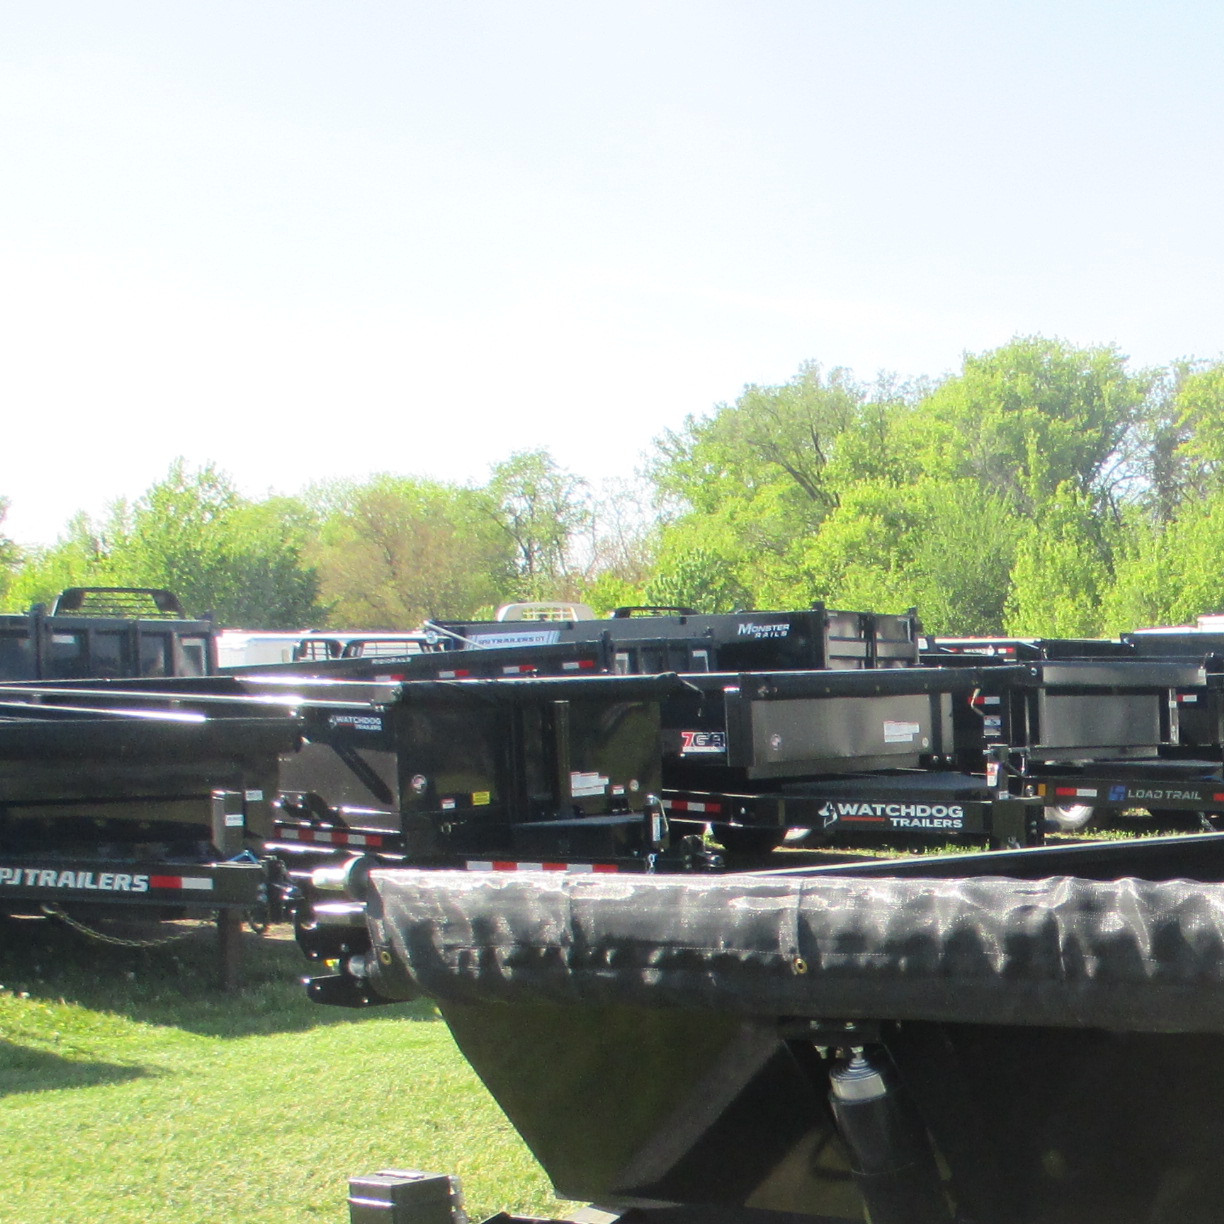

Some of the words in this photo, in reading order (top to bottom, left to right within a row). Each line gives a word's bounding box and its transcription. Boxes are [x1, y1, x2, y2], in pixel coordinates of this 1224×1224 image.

[737, 623, 790, 636] MONSTER
[337, 716, 382, 725] WATCHDOG
[1128, 789, 1163, 799] LOAD
[1165, 791, 1202, 800] TRAIL
[837, 803, 963, 818] WATCHDOG
[890, 817, 963, 828] TRAILERS
